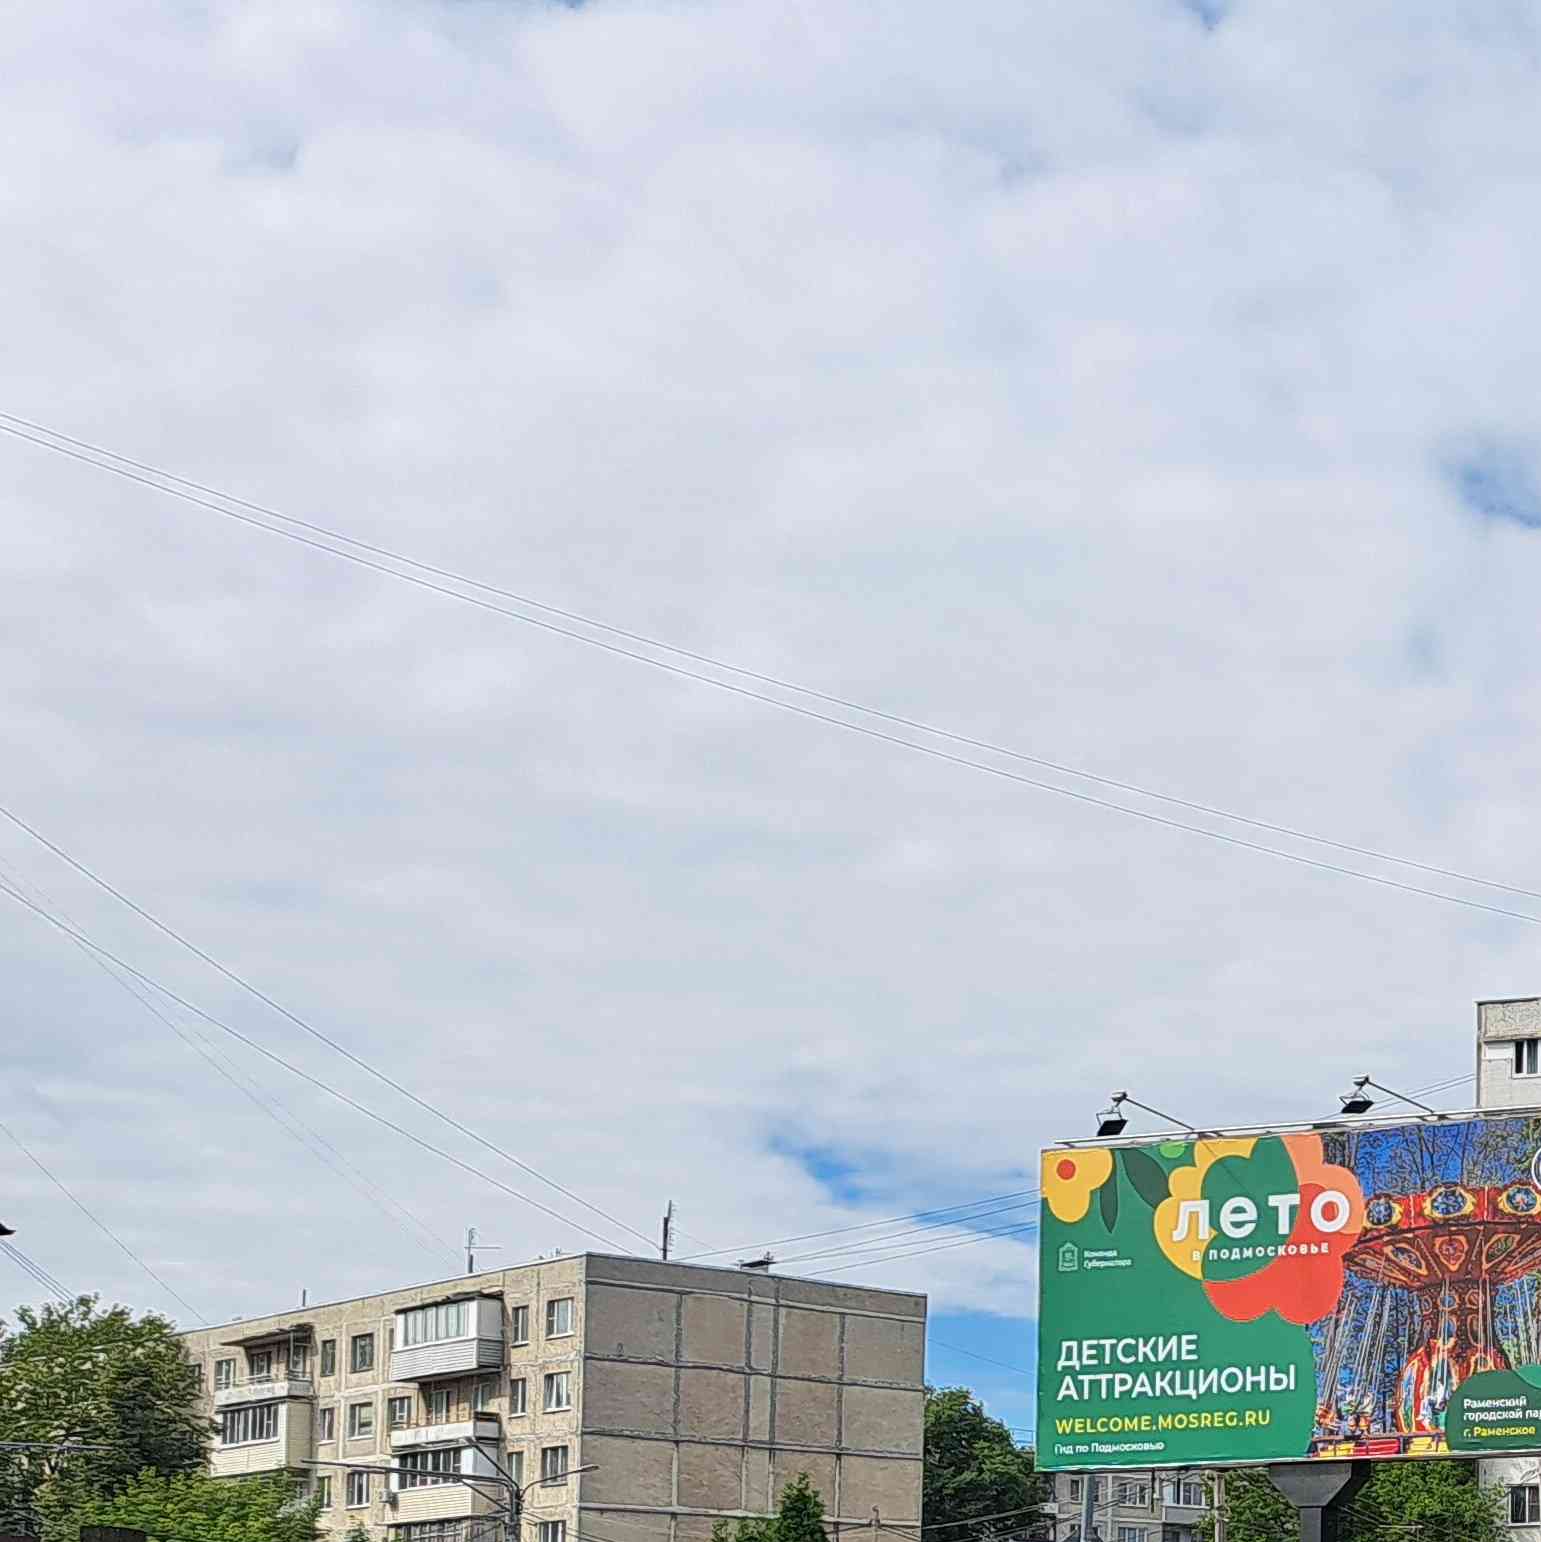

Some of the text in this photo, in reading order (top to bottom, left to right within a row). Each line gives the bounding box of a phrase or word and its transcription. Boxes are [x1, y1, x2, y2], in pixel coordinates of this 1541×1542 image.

[1057, 1334, 1199, 1371] ДЕТСКИЕ
[1057, 1364, 1296, 1401] АТТРАКЦИОНЫ
[1056, 1409, 1271, 1435] WELCOME.MOSREG.RU
[1463, 1408, 1523, 1422] городской
[1075, 1444, 1089, 1454] по
